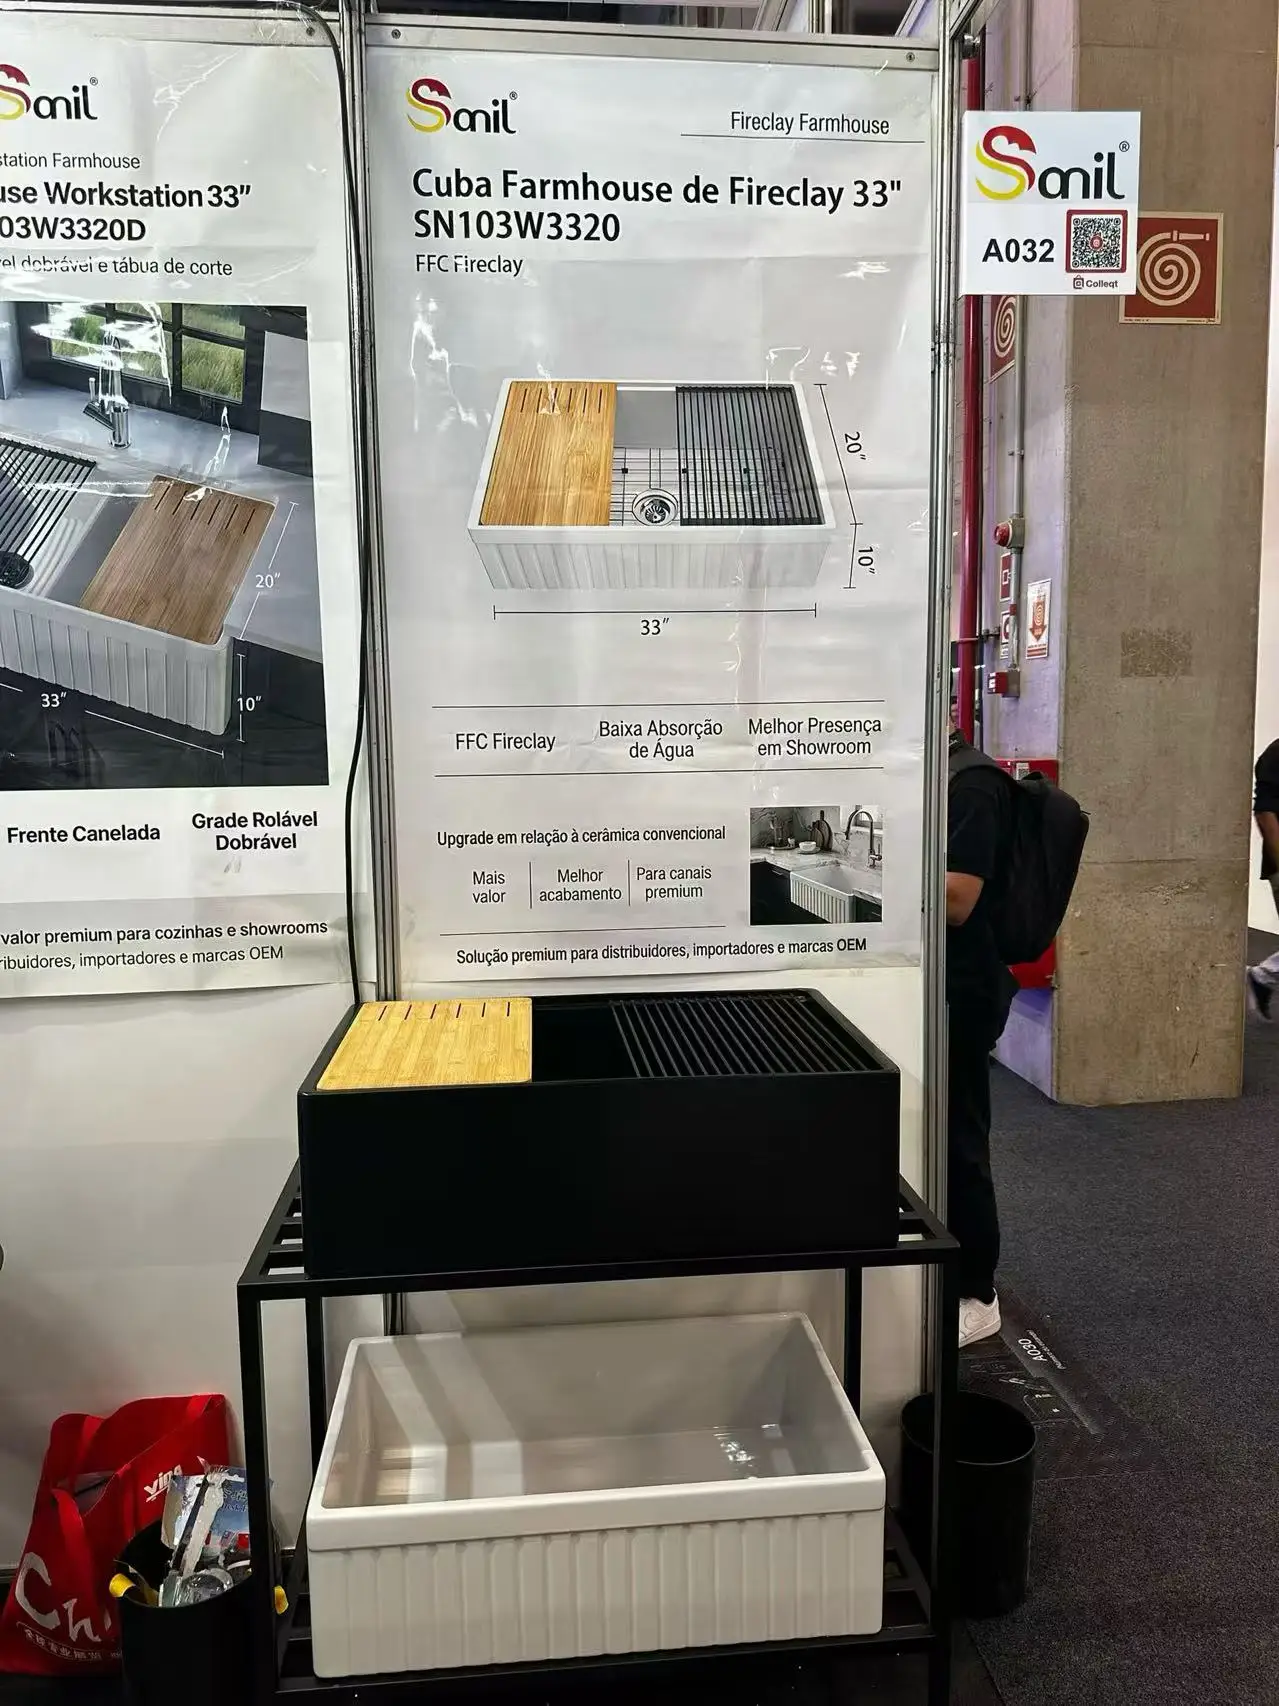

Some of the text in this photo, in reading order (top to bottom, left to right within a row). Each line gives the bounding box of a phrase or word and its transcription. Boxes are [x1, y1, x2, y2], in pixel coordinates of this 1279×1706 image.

[731, 111, 890, 136] Fireclay Farmhouse
[0, 152, 141, 170] tation Farmhouse
[43, 181, 203, 208] Workstation
[412, 167, 492, 198] Cuba
[502, 169, 673, 203] Farmhouse
[682, 174, 720, 204] de
[729, 176, 845, 215] Fireclay
[414, 209, 621, 242] SN103W3320
[981, 238, 1055, 263] A032
[0, 255, 16, 268] el
[98, 261, 108, 273] e
[111, 256, 159, 274] tábua
[163, 257, 185, 274] de
[189, 260, 233, 276] corte
[415, 254, 524, 278] FFC Fireclay
[1085, 279, 1119, 289] Colleqt
[599, 718, 723, 742] Baixa Absorção
[748, 717, 882, 737] Melhor Presença
[455, 732, 556, 753] FFC Fireclay
[629, 737, 695, 762] de Água
[757, 738, 871, 756] em Showroom
[191, 810, 318, 830] Grade Rolável
[7, 823, 161, 844] Frente Canelada
[215, 832, 297, 851] Dobrável
[437, 825, 726, 849] Upgrade em relação à cerâmica convencional
[472, 870, 506, 886] Mais
[557, 868, 604, 883] Melhor
[636, 865, 712, 881] Para canais
[472, 888, 507, 904] valor
[539, 887, 622, 902] acabamento
[645, 883, 703, 903] premium
[0, 921, 328, 947] valor premium para cozinhas e showrooms
[79, 950, 176, 970] importadores
[179, 952, 189, 964] e
[192, 949, 246, 964] marcas
[249, 945, 284, 960] OEM
[456, 937, 867, 967] Solução premium para distribuidores, importadores e marcas OEM
[1018, 1338, 1048, 1362] A030
